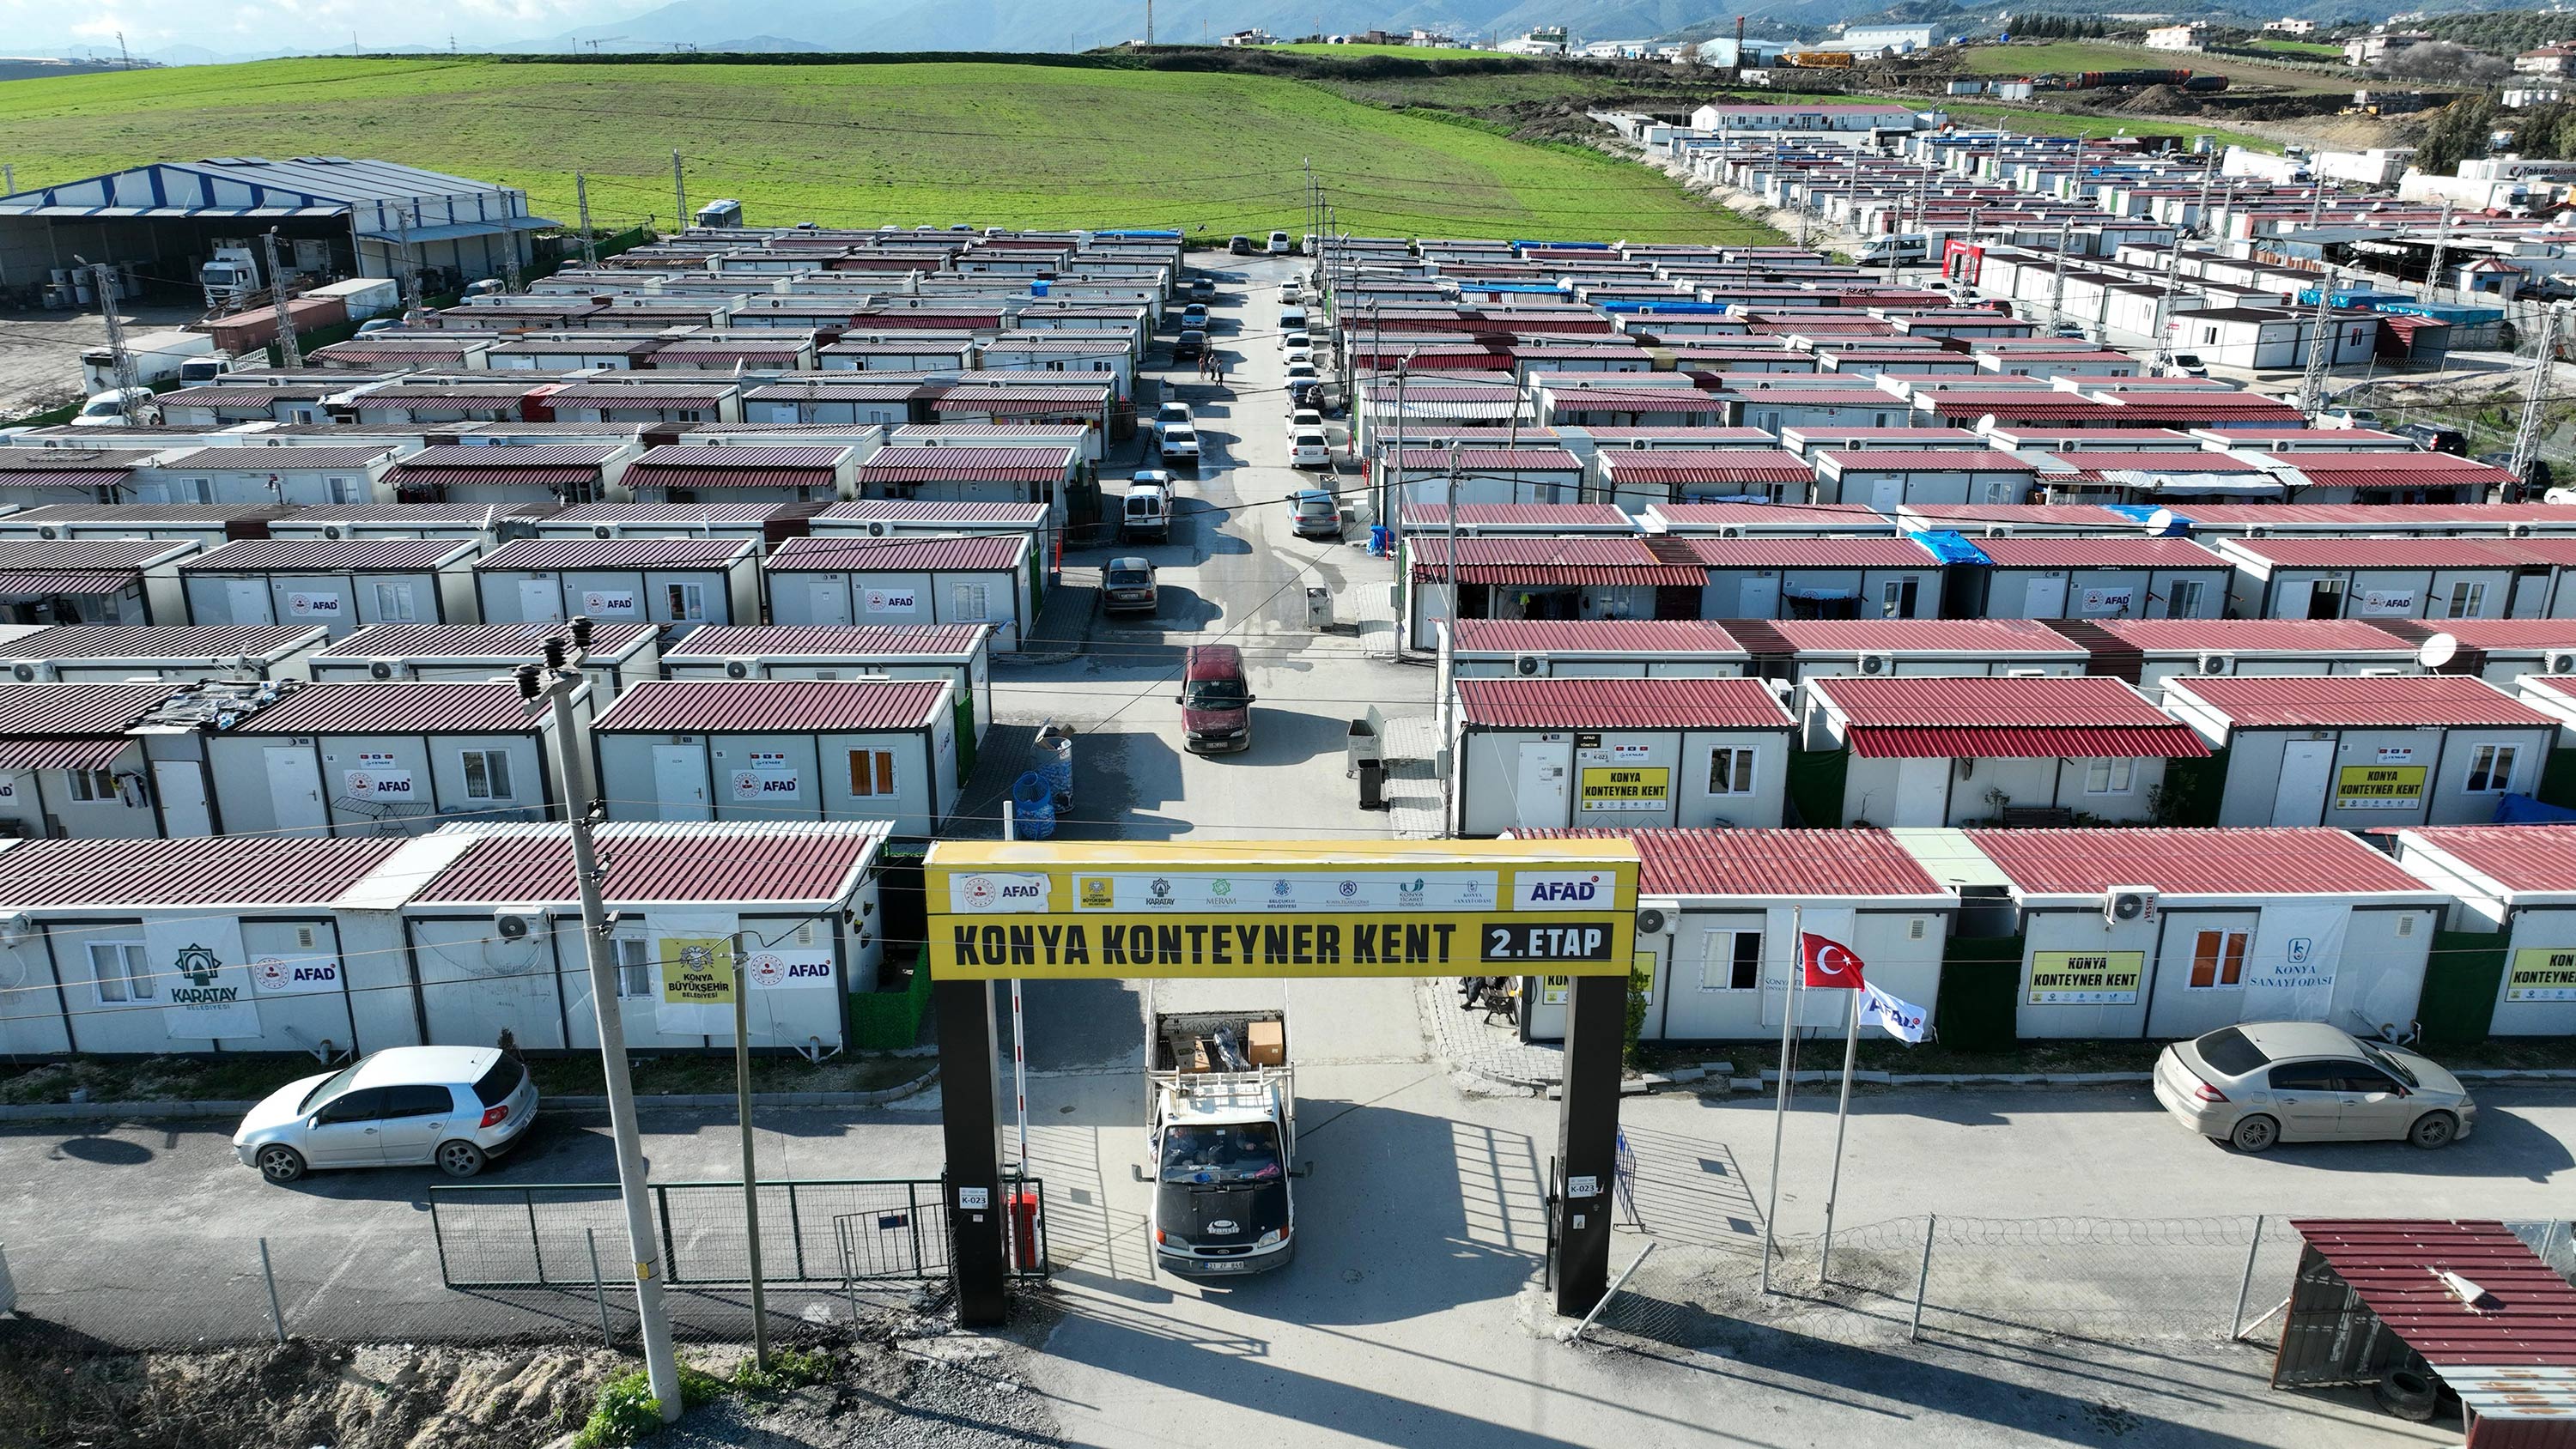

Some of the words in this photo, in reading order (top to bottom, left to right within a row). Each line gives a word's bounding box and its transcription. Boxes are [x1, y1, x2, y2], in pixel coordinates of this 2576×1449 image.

[2105, 596, 2129, 604] AFAD
[1610, 773, 1641, 782] KONYA
[2367, 771, 2397, 781] KONYA
[378, 781, 410, 791] AFAD
[763, 781, 796, 791] AFAD
[1585, 786, 1638, 796] KONTEYNER
[1641, 786, 1665, 796] KENT
[2340, 785, 2394, 794] KONTEYNER
[2396, 785, 2421, 794] KENT
[1002, 886, 1039, 897] AFAD
[1531, 882, 1595, 901] AFAD
[2144, 895, 2154, 919] VESTEL
[954, 925, 1090, 966] KONYA
[1103, 925, 1340, 965] KONTEYNER
[1353, 924, 1457, 964] KENT
[1489, 928, 1602, 957] 2.ETAP
[2068, 957, 2107, 969] KONYA
[2549, 955, 2576, 967] KON
[294, 967, 336, 981] AFAD
[788, 964, 830, 977] AFAD
[2275, 965, 2316, 975] KONYA
[683, 973, 714, 982] KONYA
[2033, 973, 2102, 985] KONTEYNER
[2106, 973, 2137, 985] KENT
[2298, 976, 2332, 987] ODASI
[2513, 971, 2576, 983] KONTEYNE
[668, 980, 729, 992] BÜYÜKŞEHİR
[171, 986, 238, 1003] KARATAY
